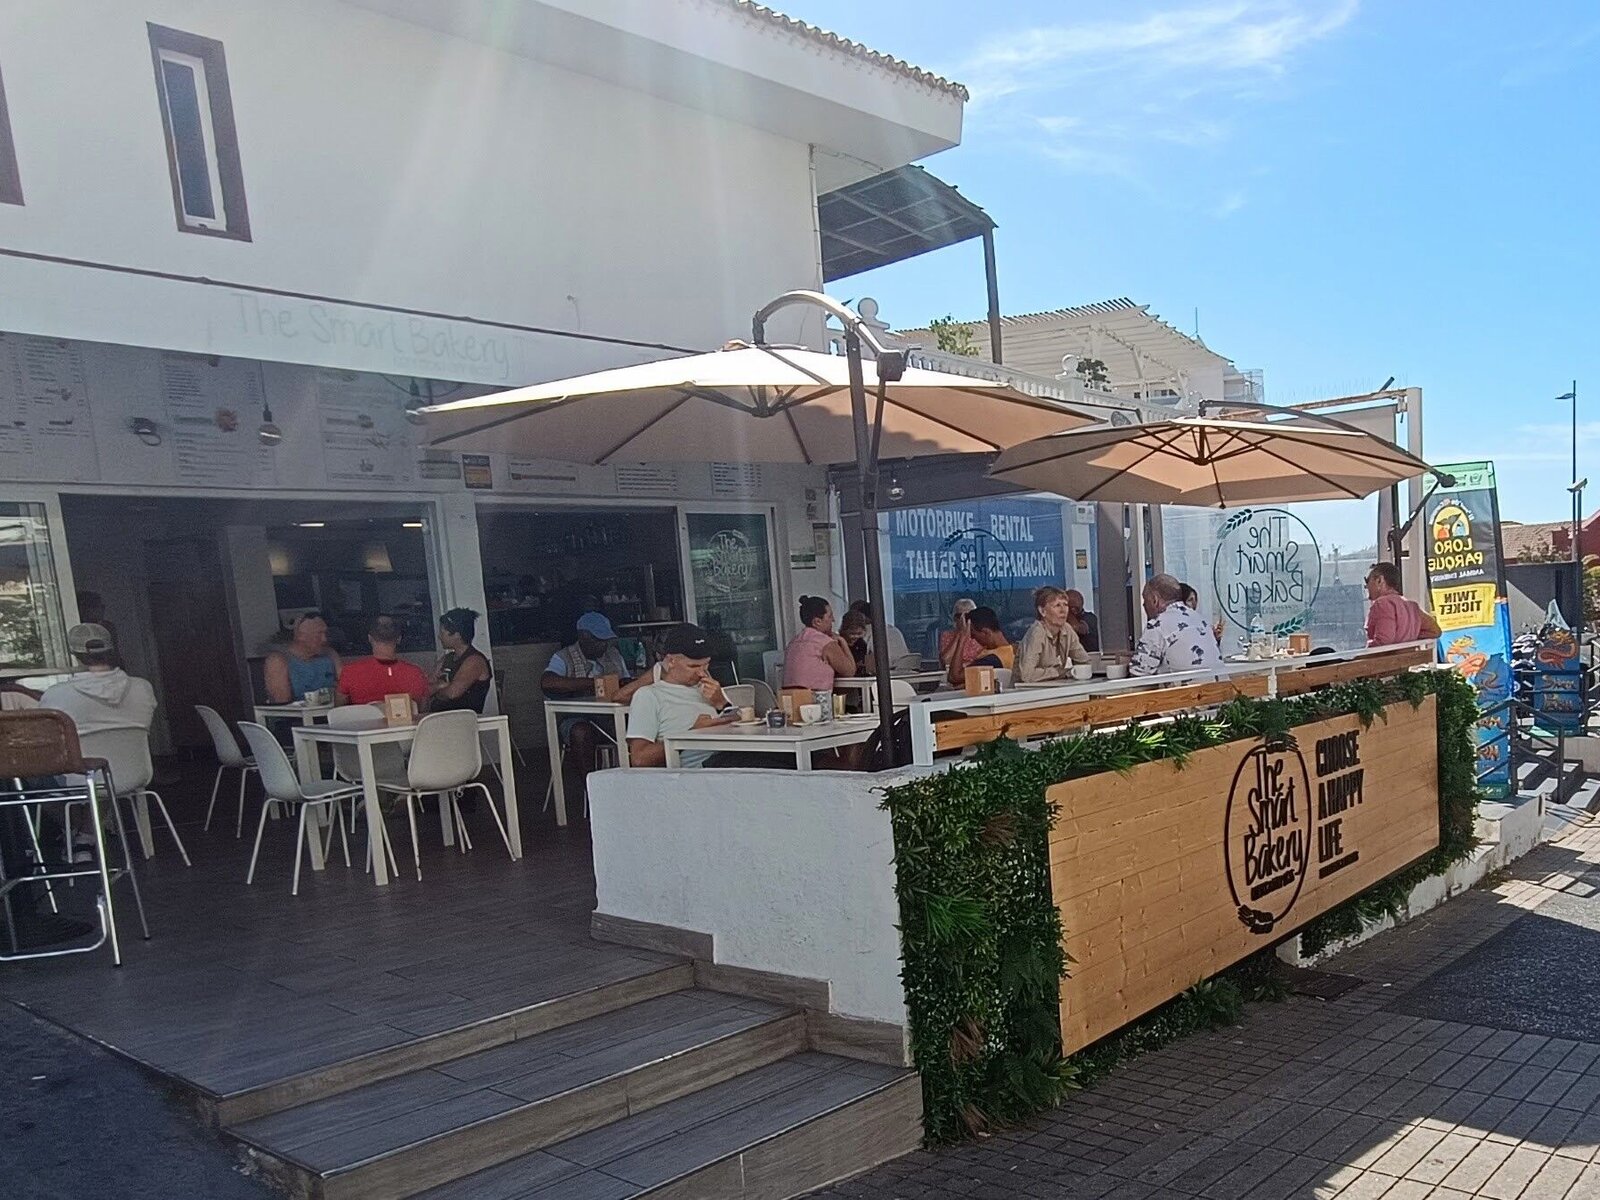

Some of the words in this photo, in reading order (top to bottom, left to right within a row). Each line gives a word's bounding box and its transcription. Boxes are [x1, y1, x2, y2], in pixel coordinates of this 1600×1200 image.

[230, 292, 299, 338] The
[307, 304, 403, 354] Smart
[408, 317, 509, 380] Bakery
[895, 510, 975, 541] MOTORBIKE
[990, 514, 1034, 542] RENTAL
[905, 549, 957, 580] TALLER
[988, 546, 1056, 578] REPARACIÓN
[1249, 748, 1284, 801] The
[1315, 729, 1361, 777] CHOOSE
[1247, 776, 1299, 837] Smart
[1318, 782, 1328, 820] A
[1327, 768, 1364, 817] HAPPY
[1243, 828, 1303, 887] Bakery
[1317, 817, 1344, 864] LIFE
